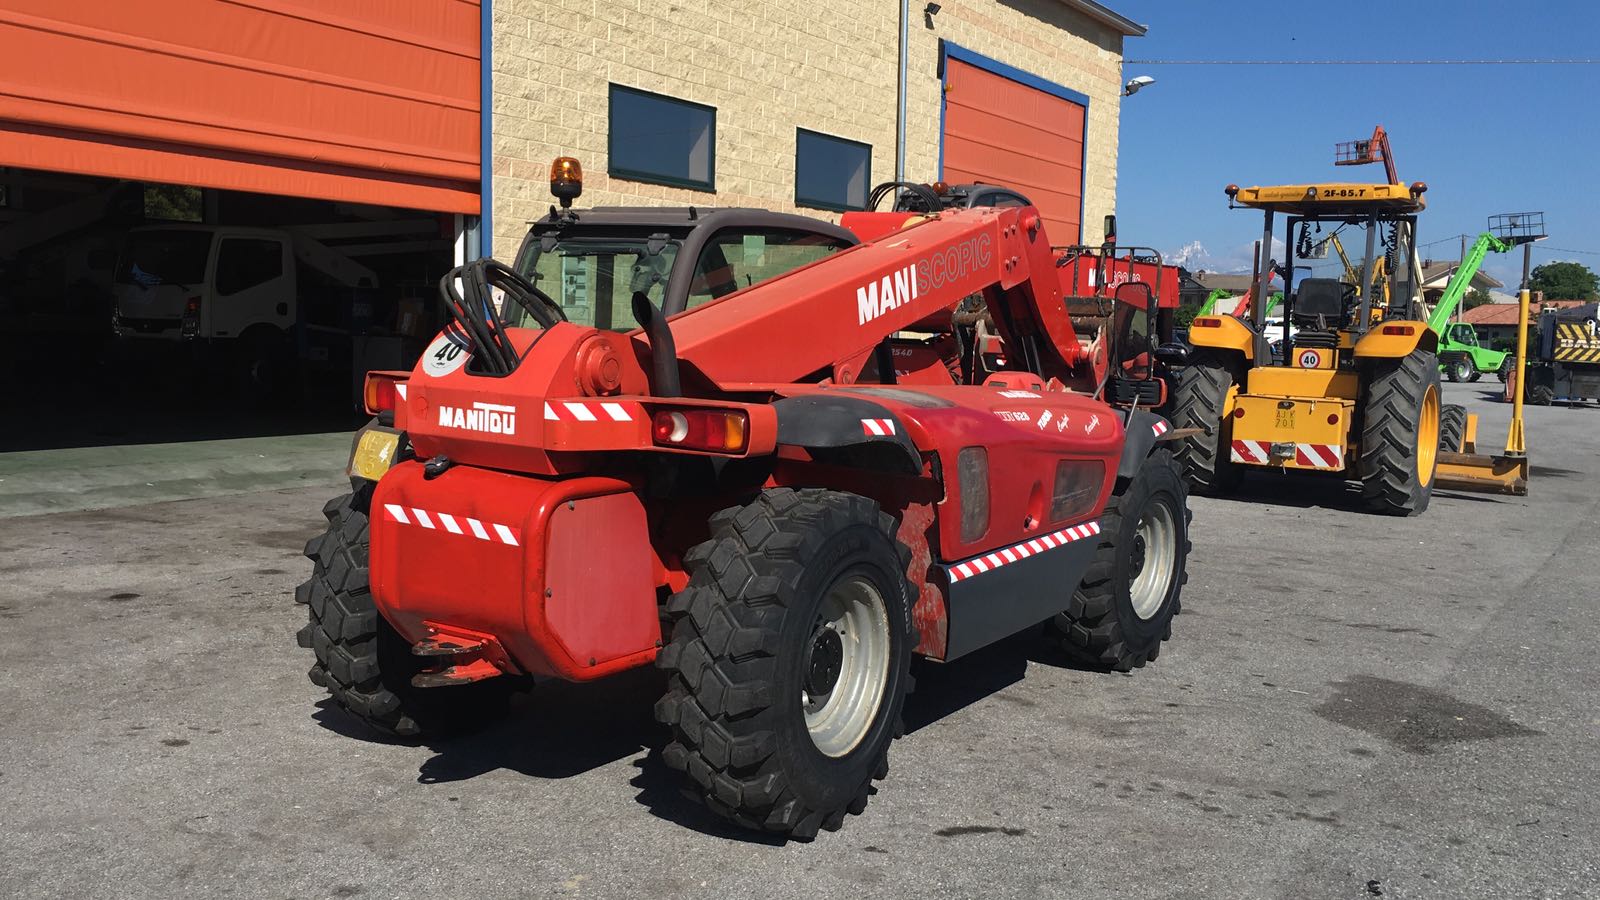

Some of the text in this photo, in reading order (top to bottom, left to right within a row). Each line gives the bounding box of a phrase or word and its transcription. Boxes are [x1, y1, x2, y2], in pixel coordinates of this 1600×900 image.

[1324, 189, 1366, 197] 2F-85.T
[857, 233, 991, 326] MANISCOPIC
[434, 343, 463, 361] 40
[1303, 356, 1316, 364] 40
[438, 402, 516, 435] MANITOU
